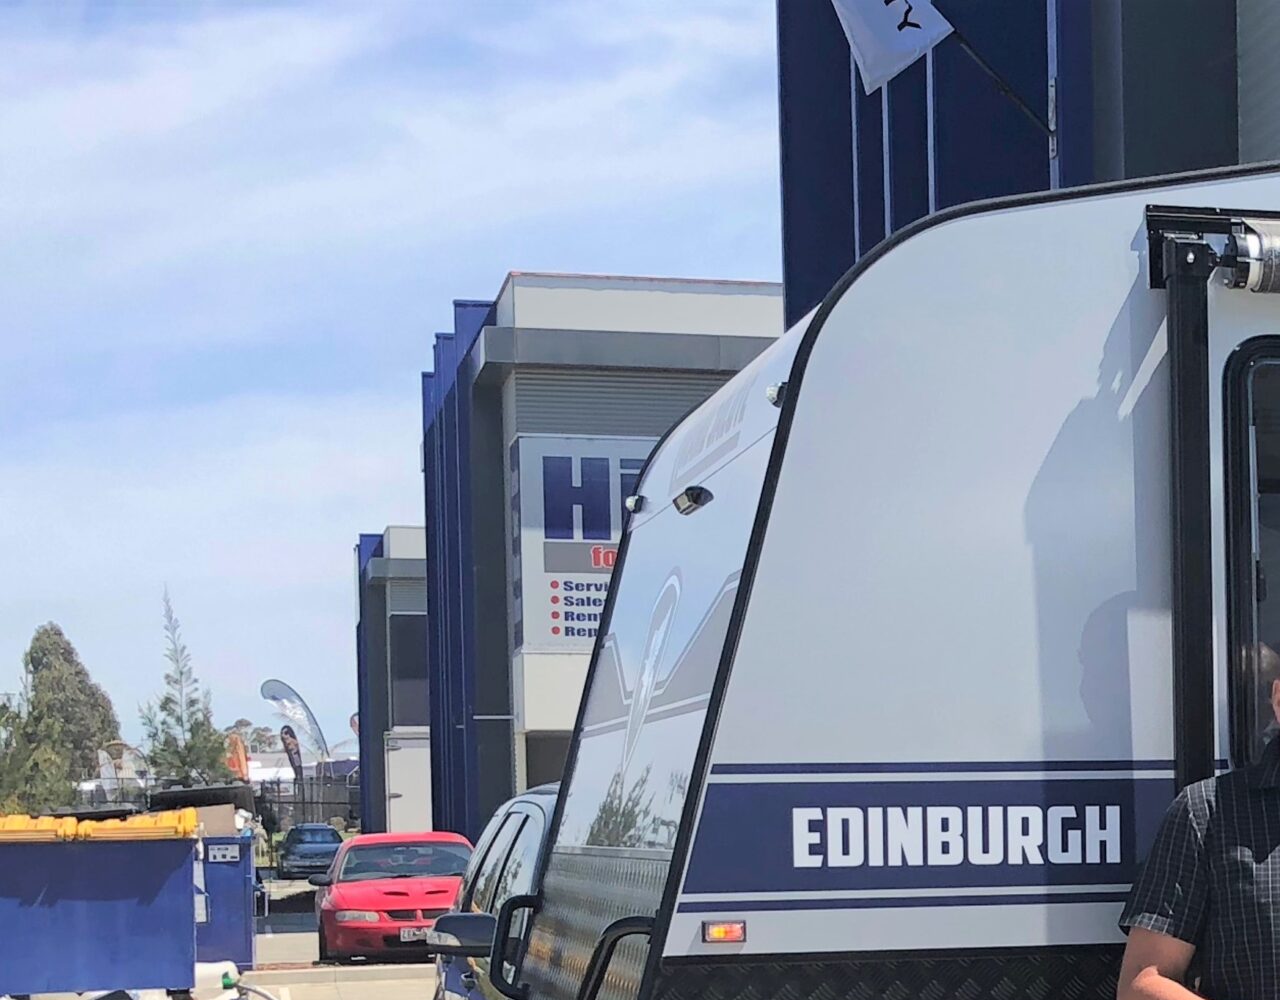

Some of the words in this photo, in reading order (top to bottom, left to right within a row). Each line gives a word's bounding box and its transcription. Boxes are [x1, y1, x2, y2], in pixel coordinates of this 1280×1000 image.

[563, 595, 606, 607] Sale
[564, 611, 603, 622] Ren
[792, 805, 1121, 868] EDINBURGH
